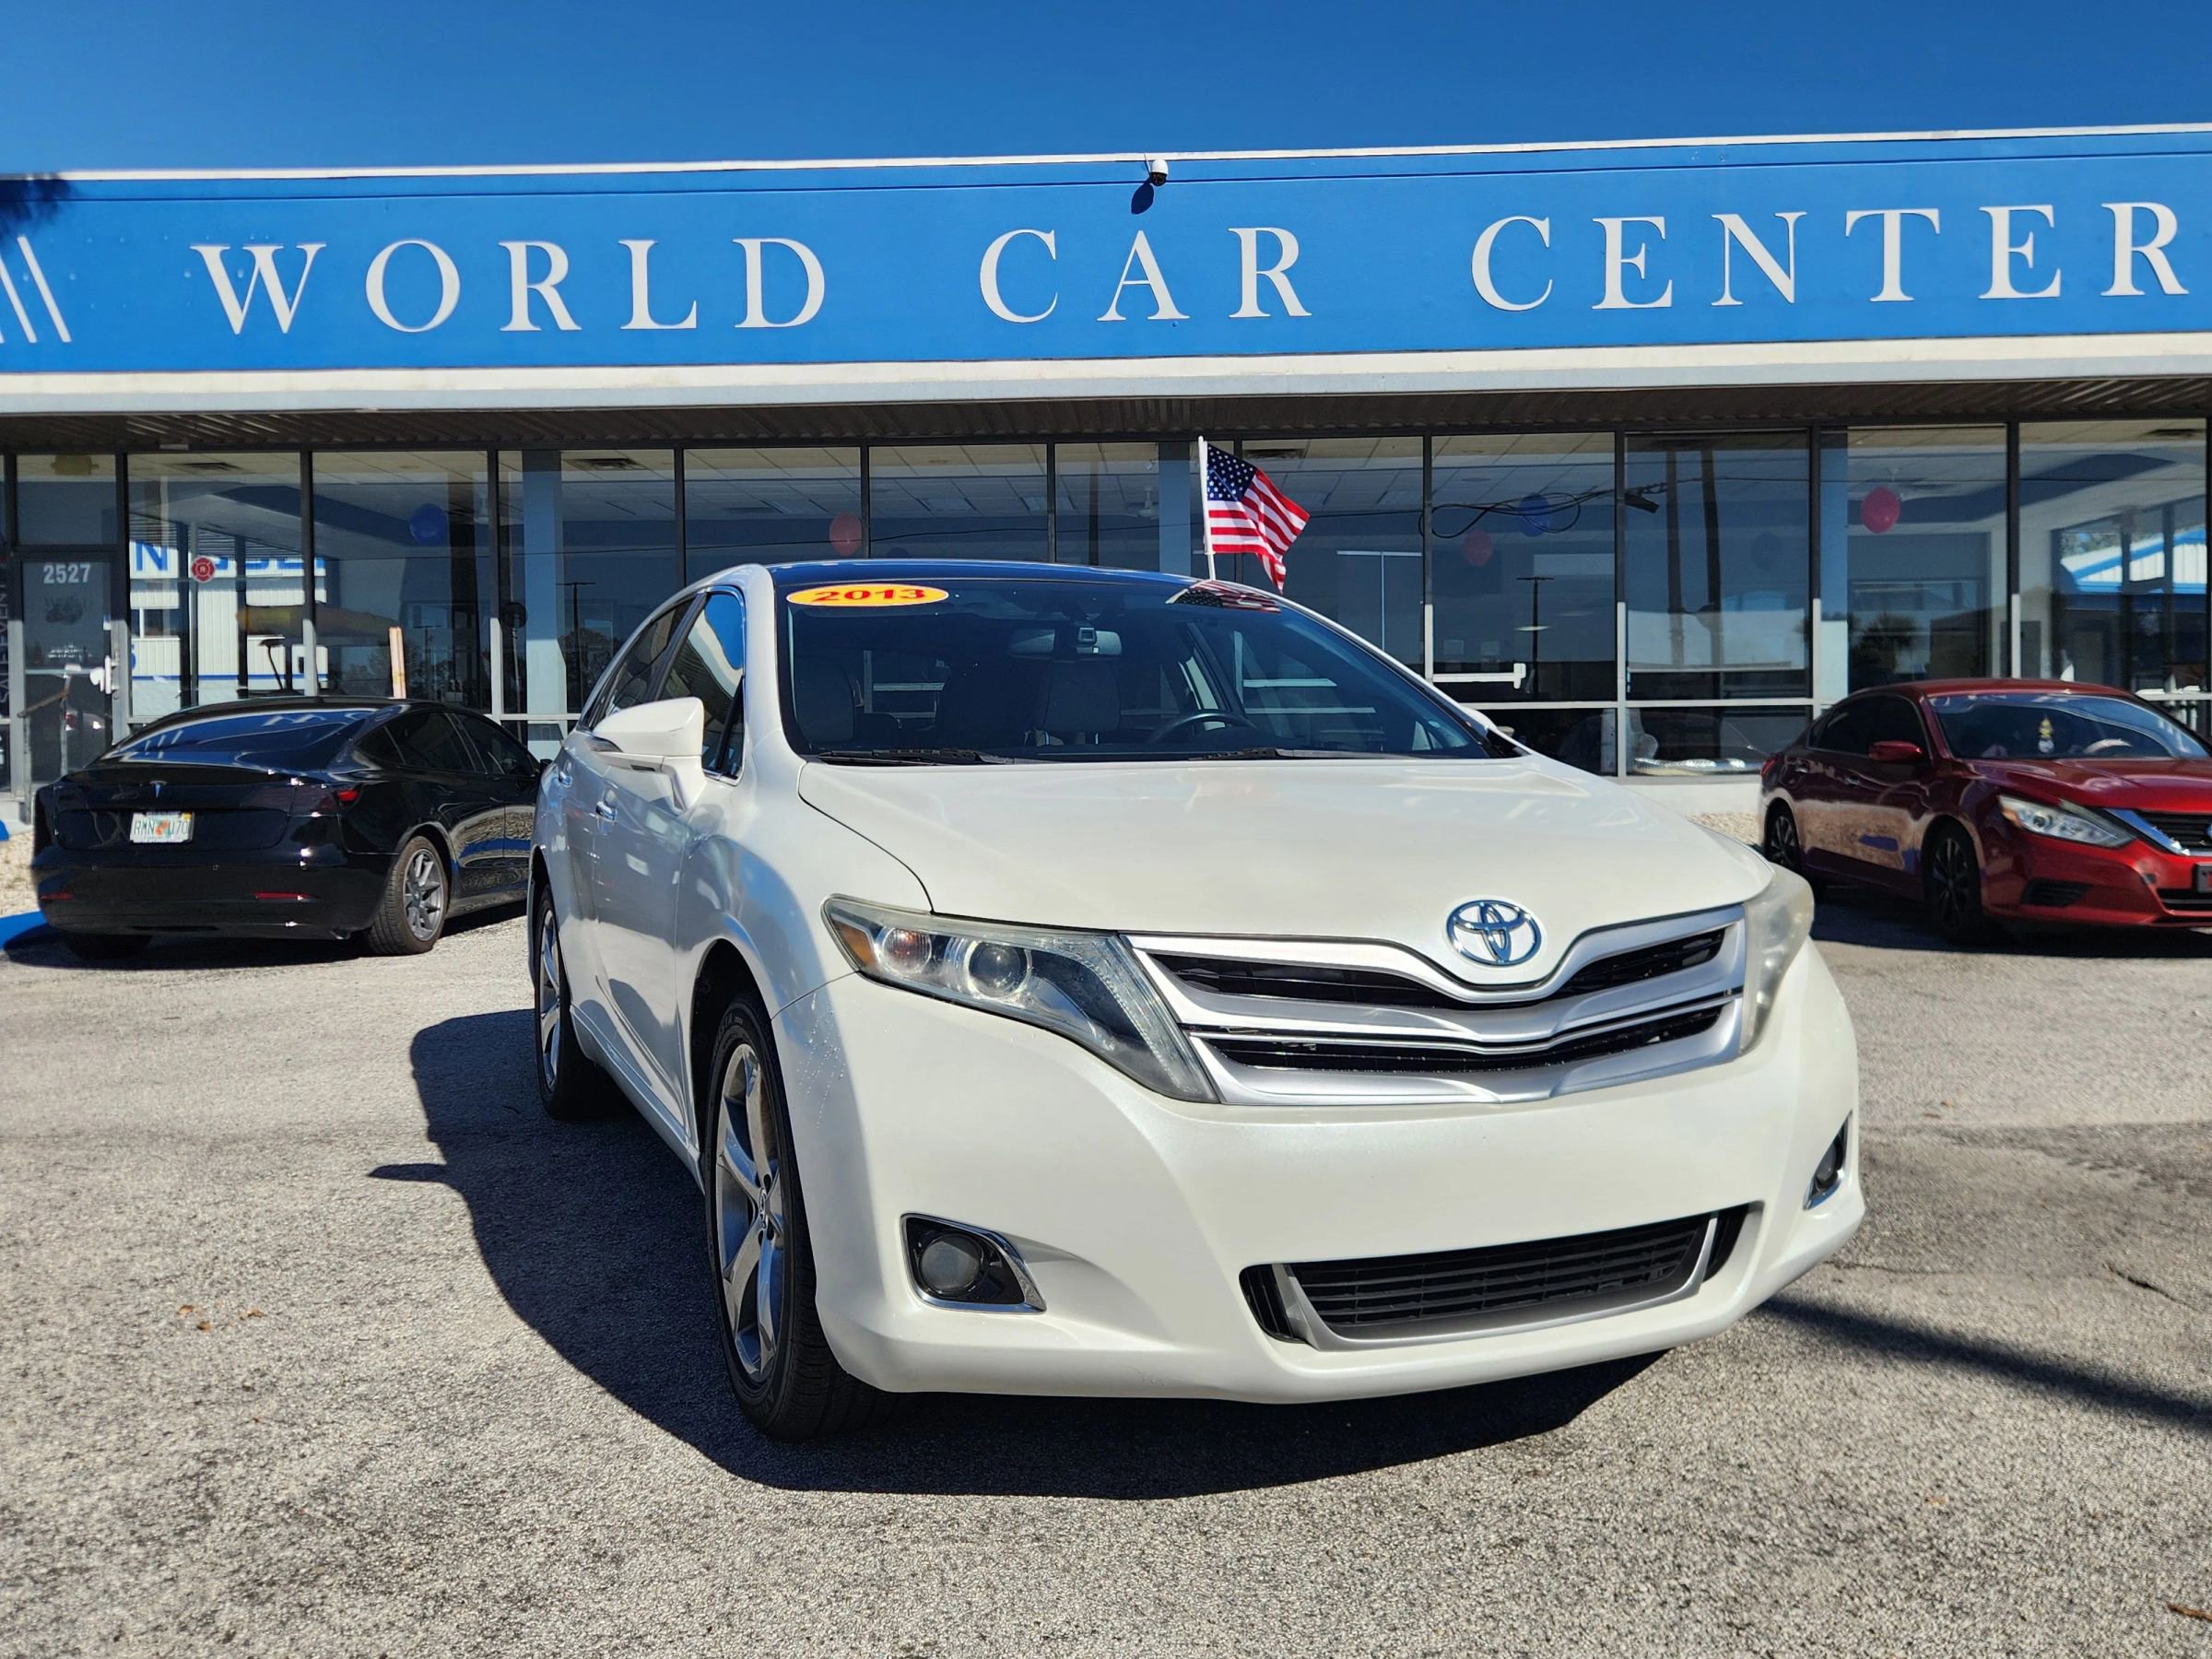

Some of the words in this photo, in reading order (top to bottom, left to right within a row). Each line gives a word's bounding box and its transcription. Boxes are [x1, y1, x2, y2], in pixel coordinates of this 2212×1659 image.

[190, 238, 825, 335] WORLD
[980, 227, 1312, 323] CAR
[1472, 202, 2189, 312] CENTER
[43, 563, 90, 584] 2527
[812, 589, 925, 603] 2013
